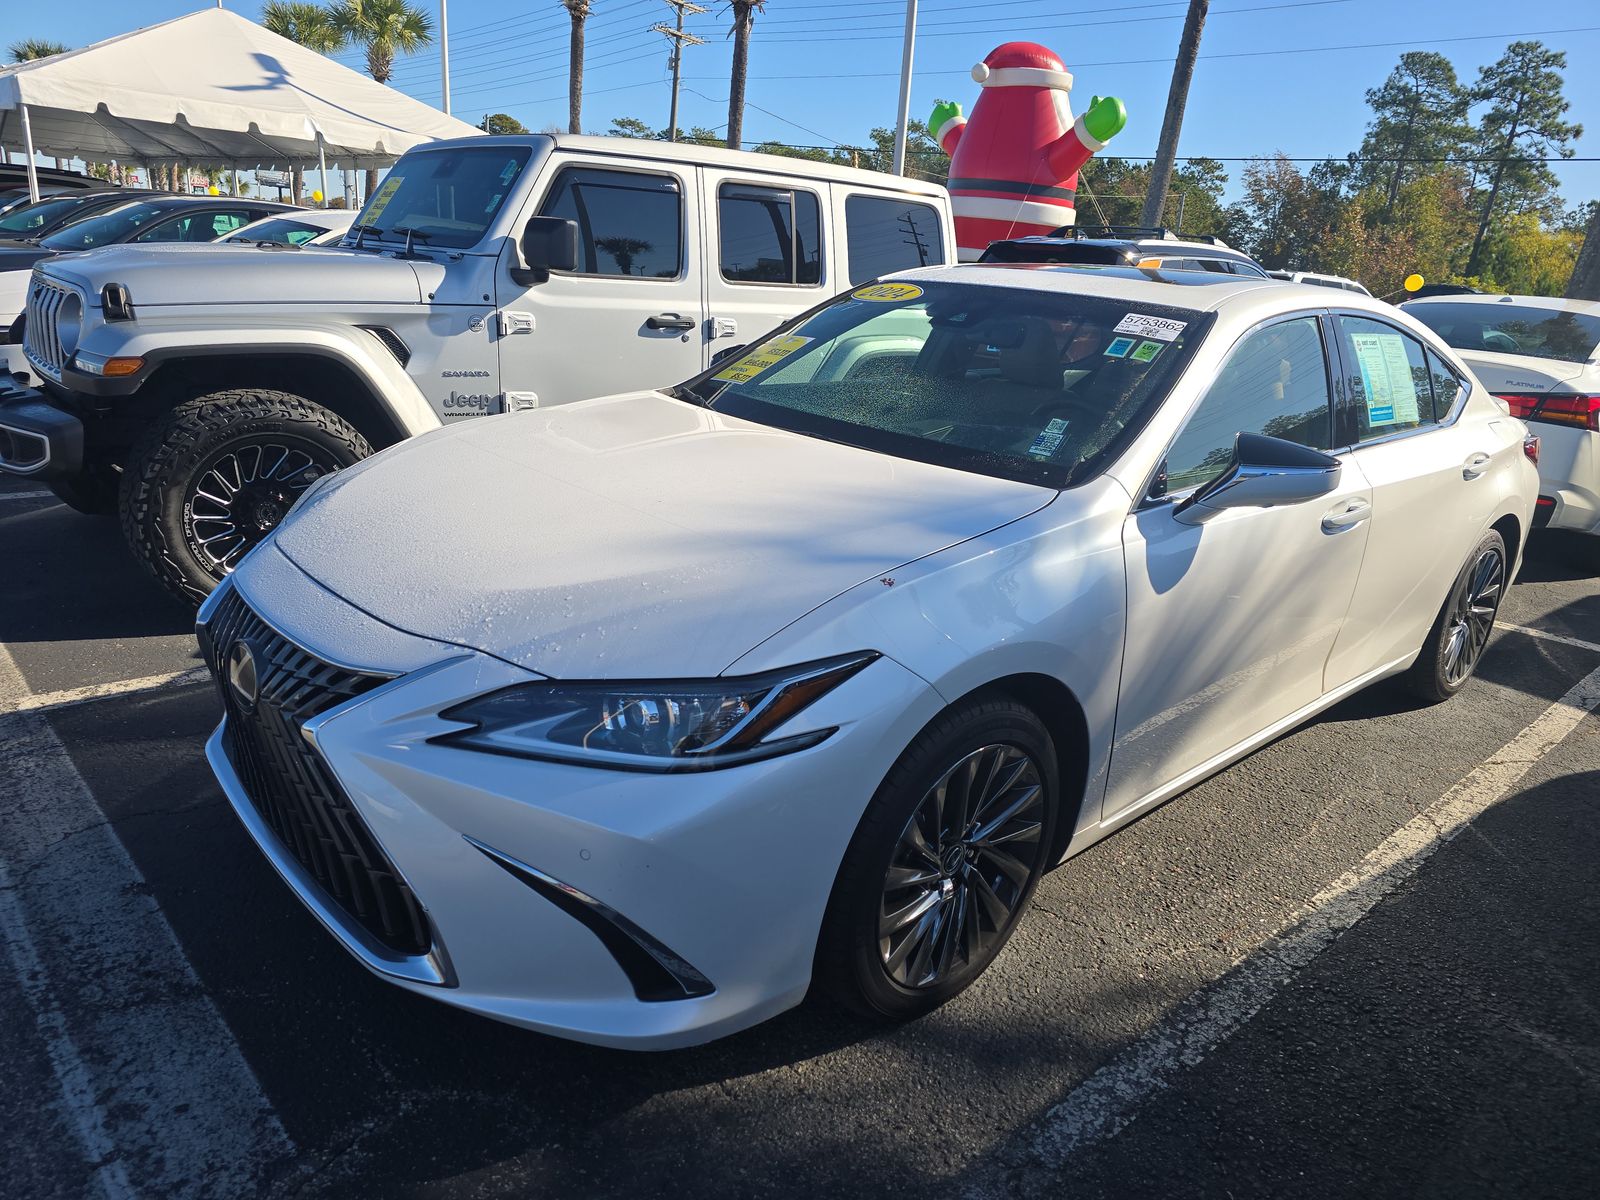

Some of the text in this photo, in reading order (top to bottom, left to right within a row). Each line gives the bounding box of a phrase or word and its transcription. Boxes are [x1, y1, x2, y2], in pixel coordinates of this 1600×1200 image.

[859, 286, 916, 298] 2024
[1124, 315, 1185, 331] 5753862
[441, 370, 490, 378] SAHARA
[1505, 380, 1545, 389] PLATINUM
[443, 391, 491, 410] Jeep
[190, 541, 214, 572] SCORPION
